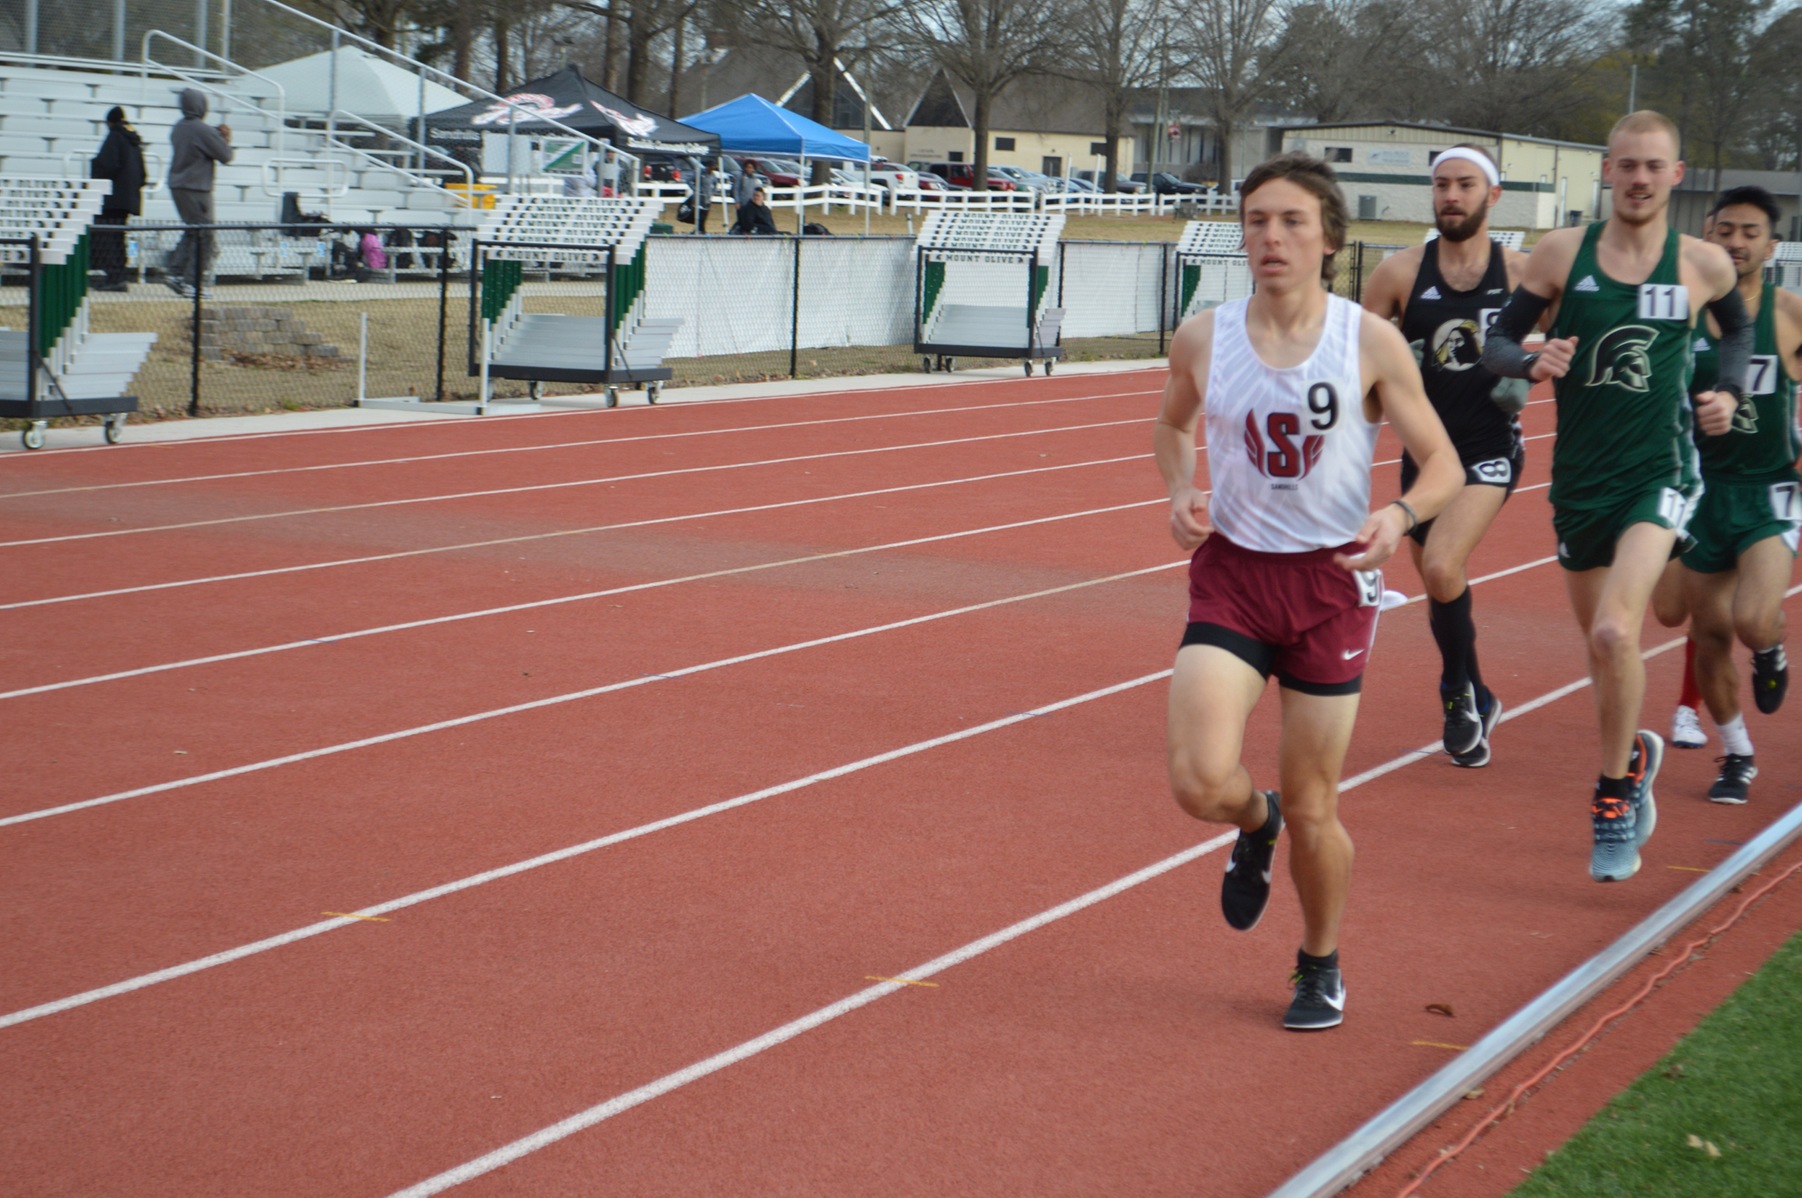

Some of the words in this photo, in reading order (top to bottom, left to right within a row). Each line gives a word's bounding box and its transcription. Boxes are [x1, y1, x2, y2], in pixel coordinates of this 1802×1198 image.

[508, 250, 547, 260] MOUNT
[554, 252, 587, 261] OLIVE
[946, 254, 980, 262] MOUNT
[1645, 288, 1678, 317] 11
[1750, 359, 1770, 391] 7
[1307, 381, 1339, 431] 9
[1776, 485, 1795, 518] 7
